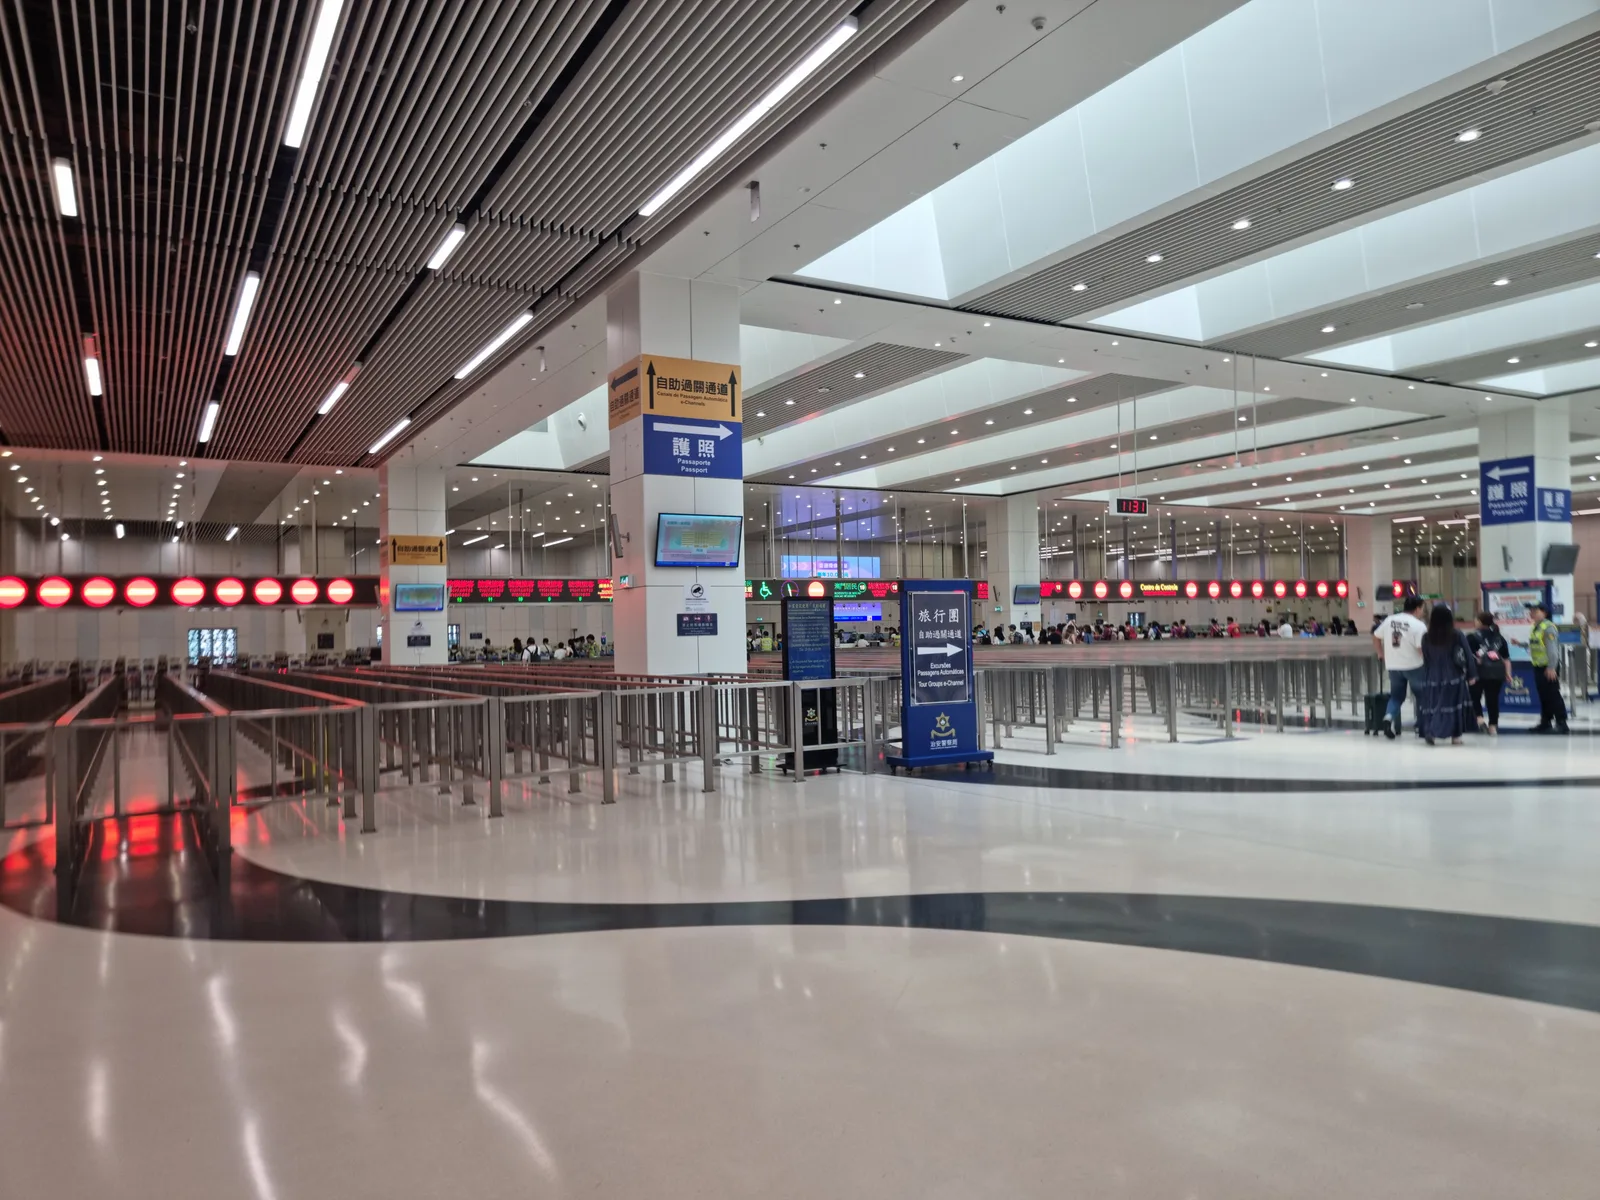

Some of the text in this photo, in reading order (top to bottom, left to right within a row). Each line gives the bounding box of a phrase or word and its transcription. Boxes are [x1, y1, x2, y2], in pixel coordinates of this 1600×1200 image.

[656, 377, 728, 396] 自助過關通道
[677, 458, 711, 467] Passaporte
[681, 466, 708, 474] Passport
[1488, 500, 1528, 509] Passaporte
[1492, 507, 1524, 516] Passport
[918, 608, 959, 623] 旅行團
[918, 629, 962, 639] 自助過關通道
[917, 669, 940, 677] Passagens
